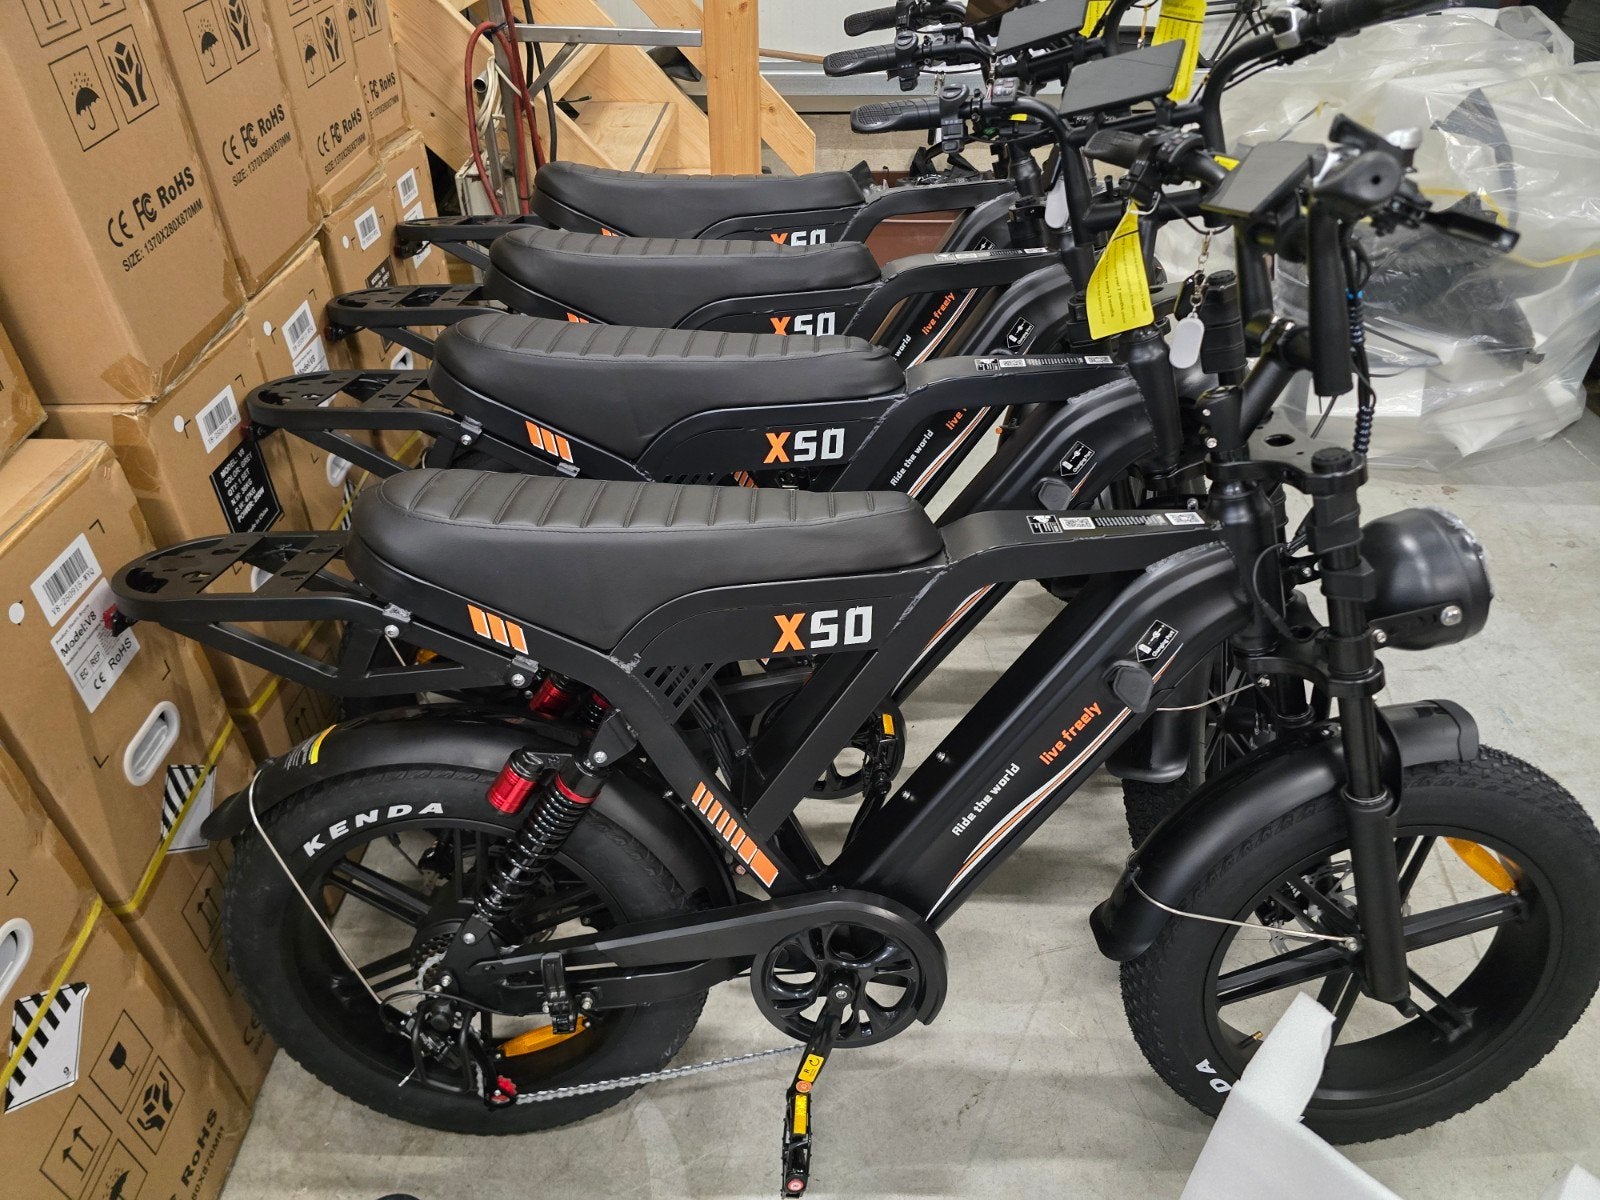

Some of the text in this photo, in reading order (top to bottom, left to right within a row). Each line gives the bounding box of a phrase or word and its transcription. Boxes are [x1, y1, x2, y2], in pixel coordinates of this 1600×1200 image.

[379, 72, 396, 92] RoHS
[257, 104, 285, 137] RoHS
[342, 108, 362, 134] RoHS
[232, 168, 248, 187] SIZE:
[108, 210, 133, 247] CE
[156, 166, 194, 208] RoHS
[122, 198, 203, 272] SIZE: 1370X280X870MM
[770, 312, 836, 337] X50
[921, 292, 955, 335] live freely
[895, 334, 912, 357] world
[945, 411, 963, 431] live
[763, 428, 845, 463] X50
[890, 429, 934, 487] Ride the world
[241, 467, 250, 481] SET
[60, 611, 97, 658] Model:V8
[772, 605, 873, 653] X50
[80, 651, 101, 682] EC REP
[108, 637, 132, 670] RoHS
[1039, 702, 1102, 766] live freely
[951, 762, 1021, 836] Ride the world
[303, 802, 444, 857] KENDA
[181, 1108, 217, 1187] RoHS
